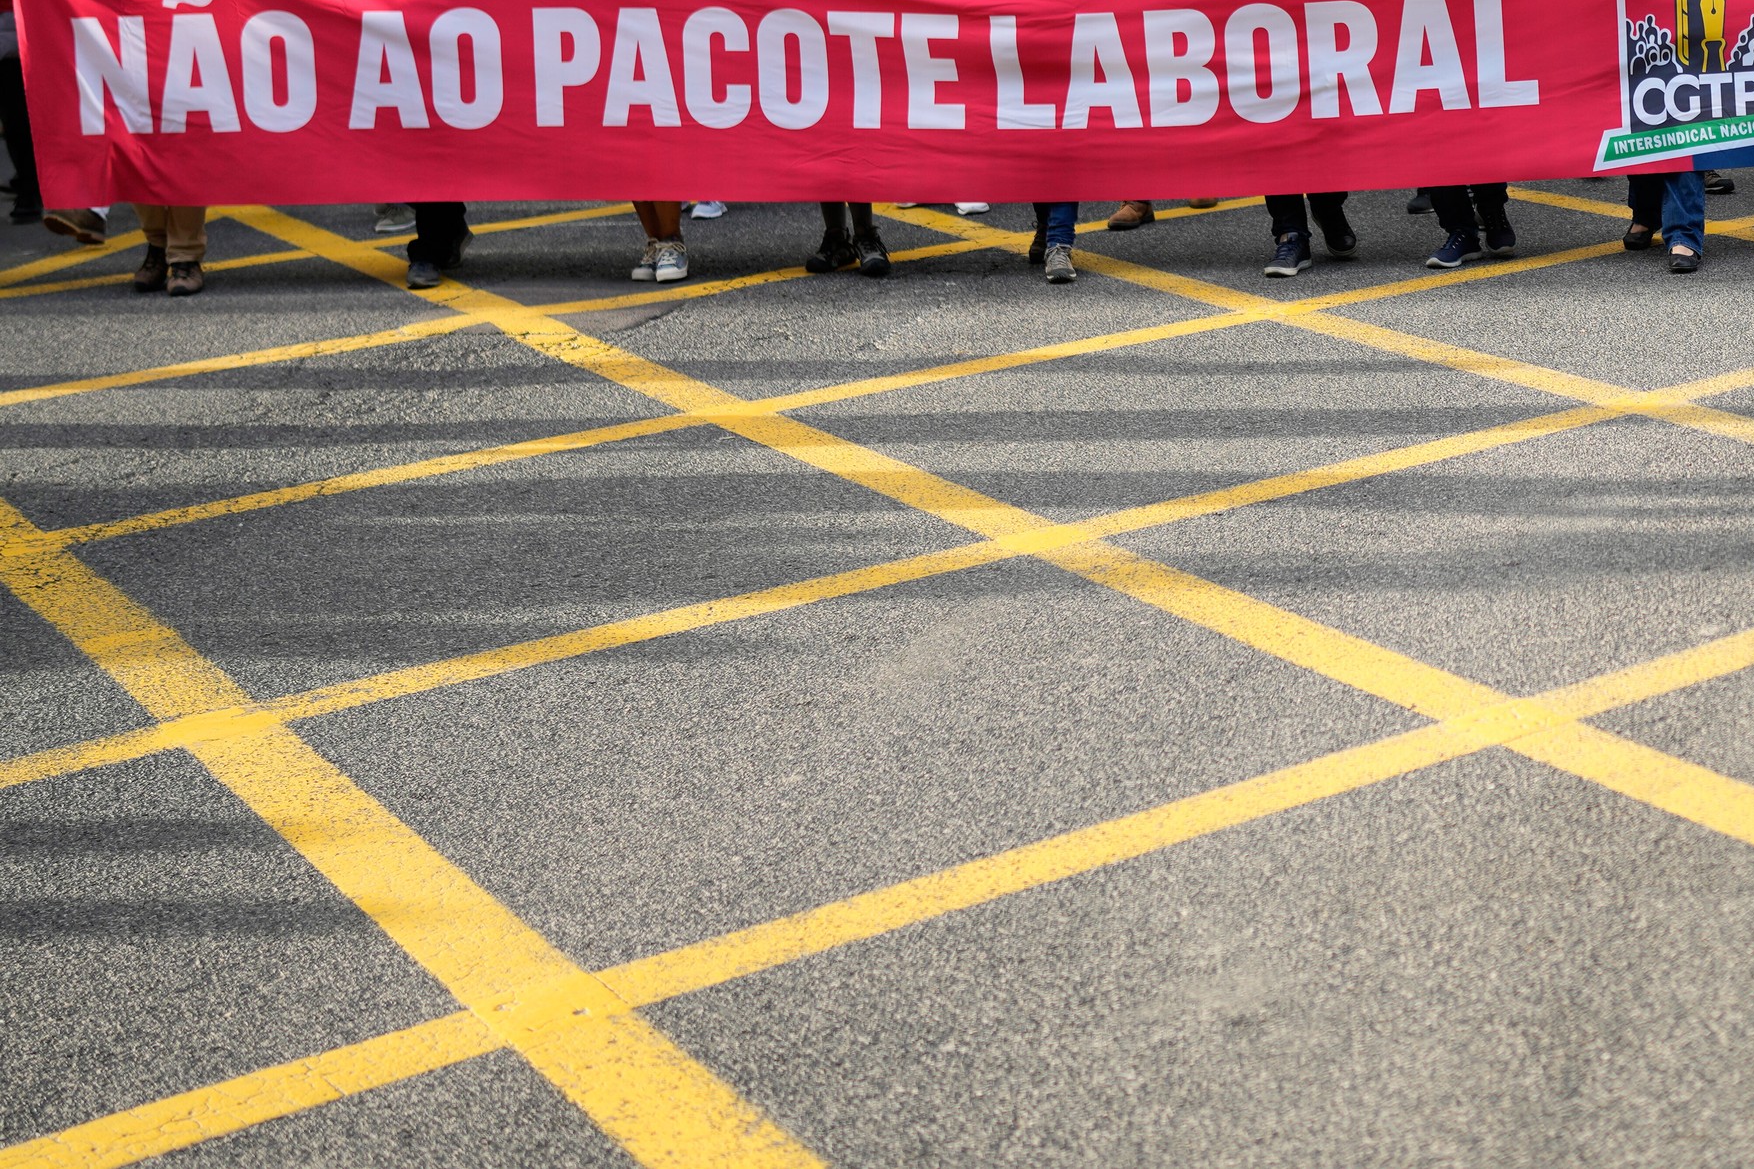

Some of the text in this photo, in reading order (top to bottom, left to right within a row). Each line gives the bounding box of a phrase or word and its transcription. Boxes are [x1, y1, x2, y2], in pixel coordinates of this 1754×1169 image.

[349, 6, 503, 131] AO
[533, 6, 966, 130] PACOTE
[1614, 130, 1716, 155] INTERSINDICAL
